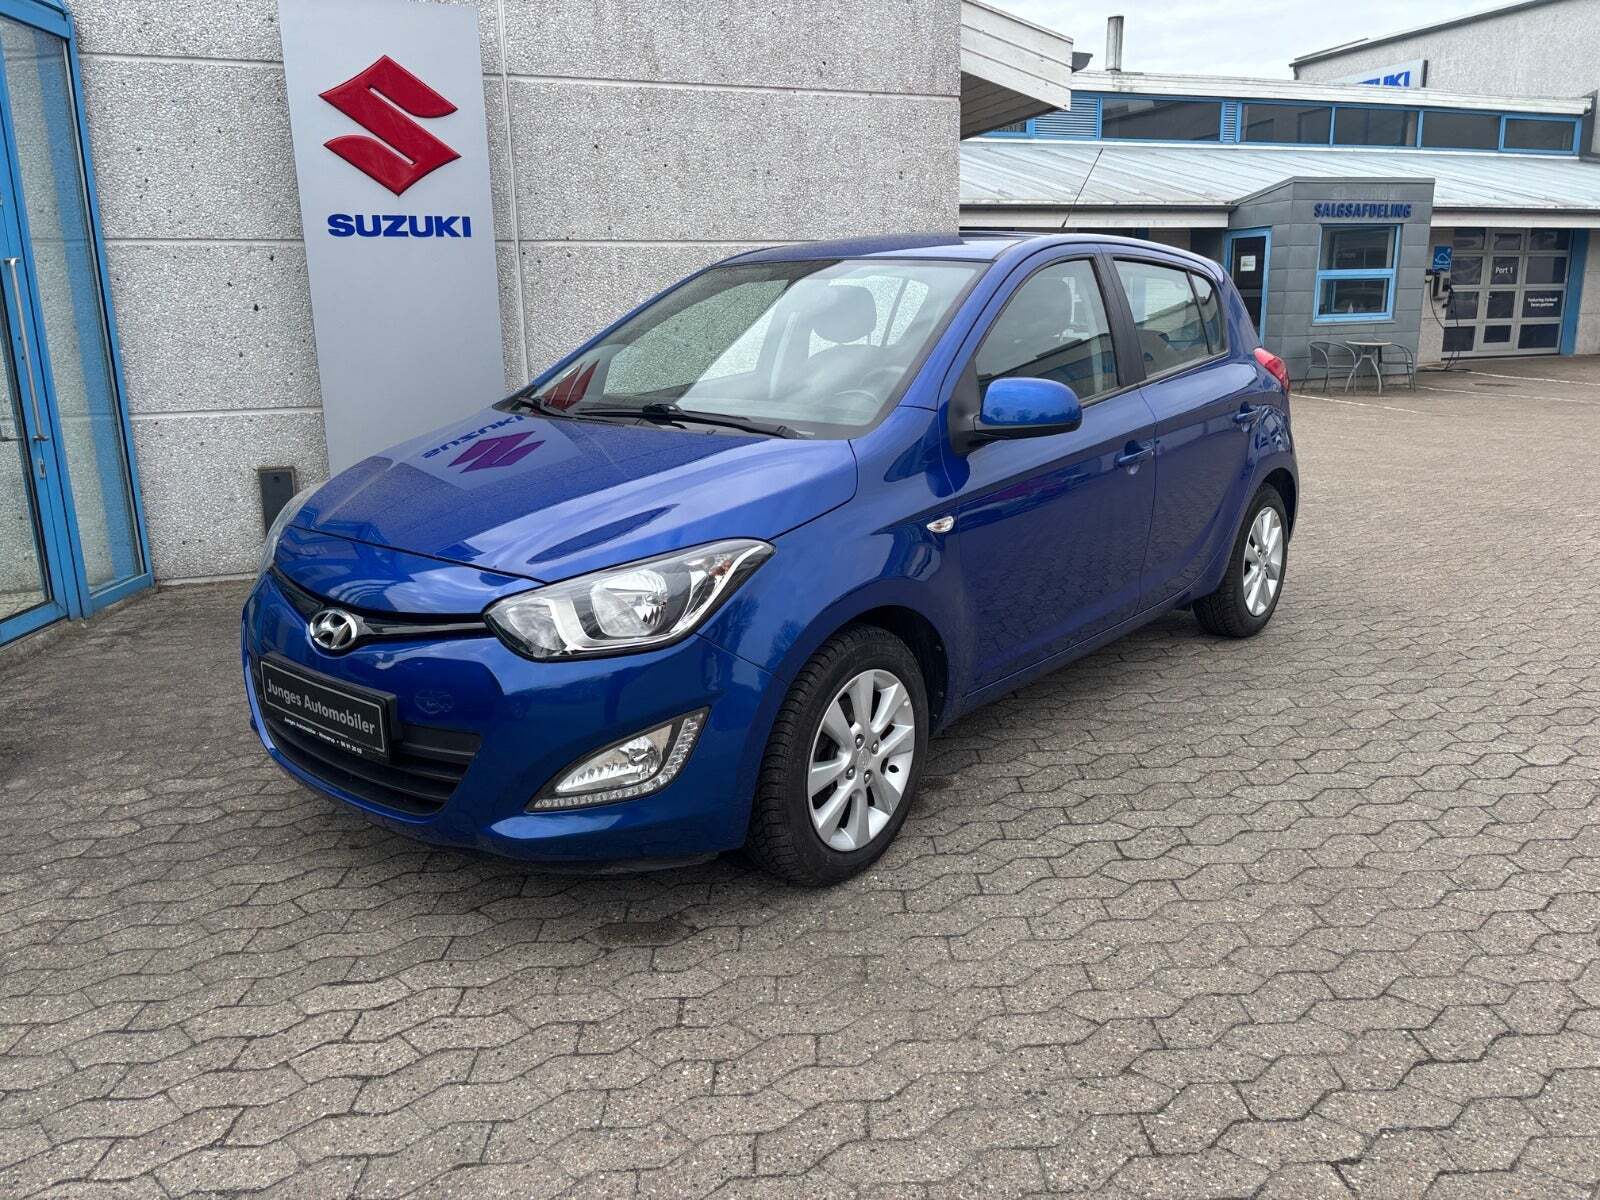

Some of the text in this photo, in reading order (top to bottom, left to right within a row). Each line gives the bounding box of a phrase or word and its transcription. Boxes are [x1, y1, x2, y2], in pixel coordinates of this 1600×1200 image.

[1313, 202, 1412, 218] SALGSAFDELING
[327, 213, 472, 238] SUZUKI
[1495, 266, 1508, 274] Port
[267, 679, 302, 706] Junges
[304, 694, 376, 735] Automobiler
